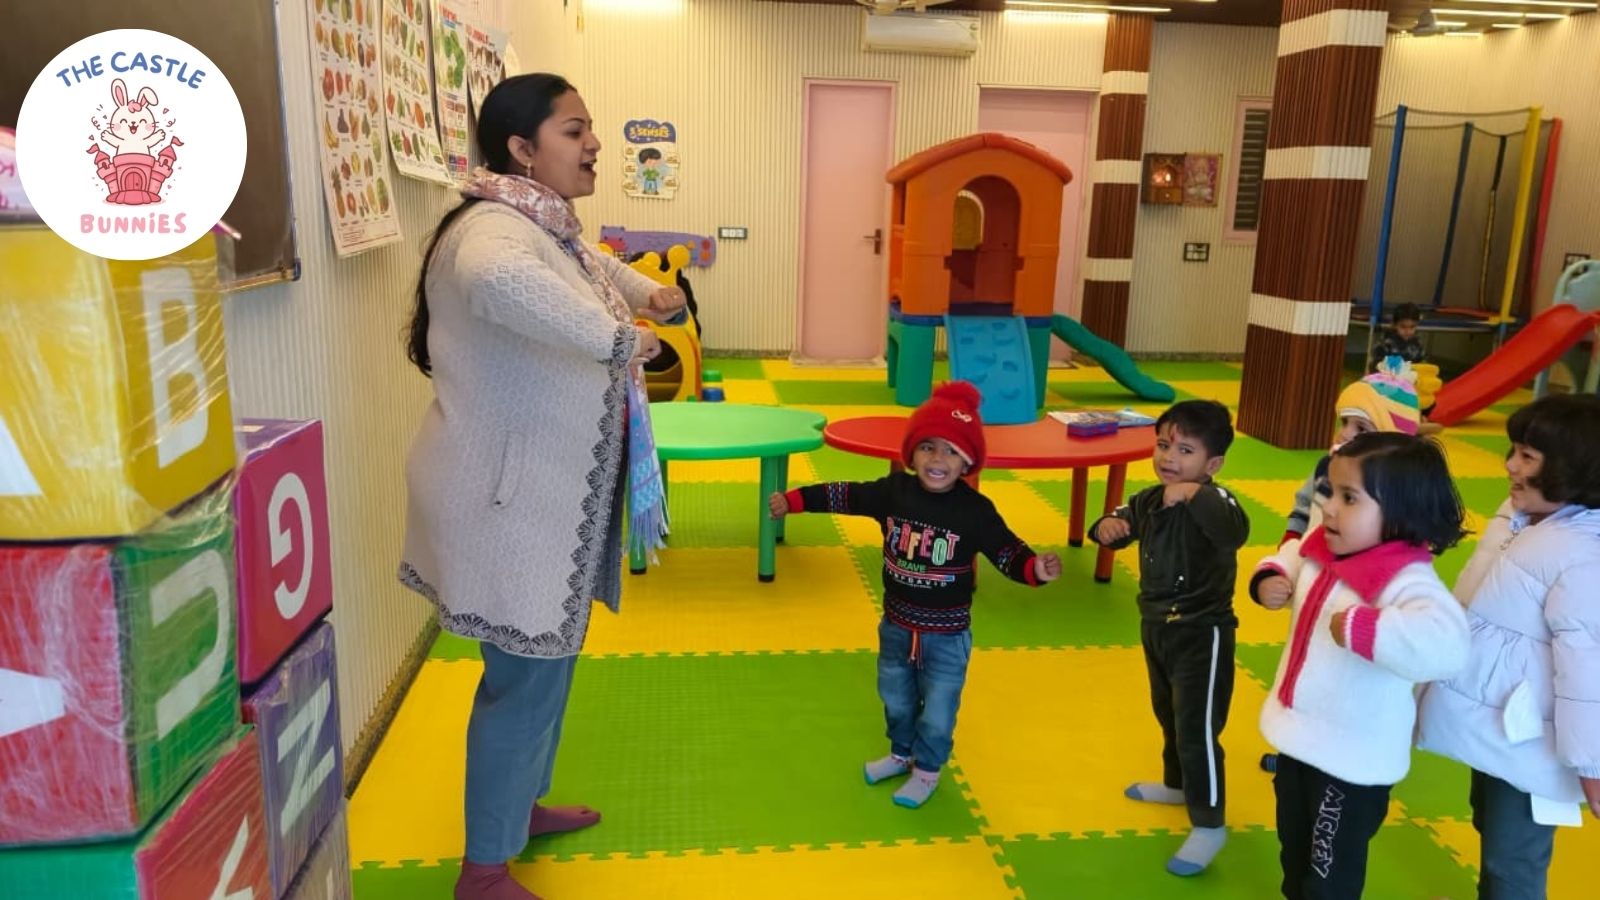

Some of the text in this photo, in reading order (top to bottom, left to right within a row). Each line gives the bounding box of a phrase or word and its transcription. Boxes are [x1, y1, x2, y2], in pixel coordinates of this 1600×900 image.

[141, 266, 208, 469] B
[267, 470, 314, 620] G
[1310, 784, 1346, 879] MICKEY
